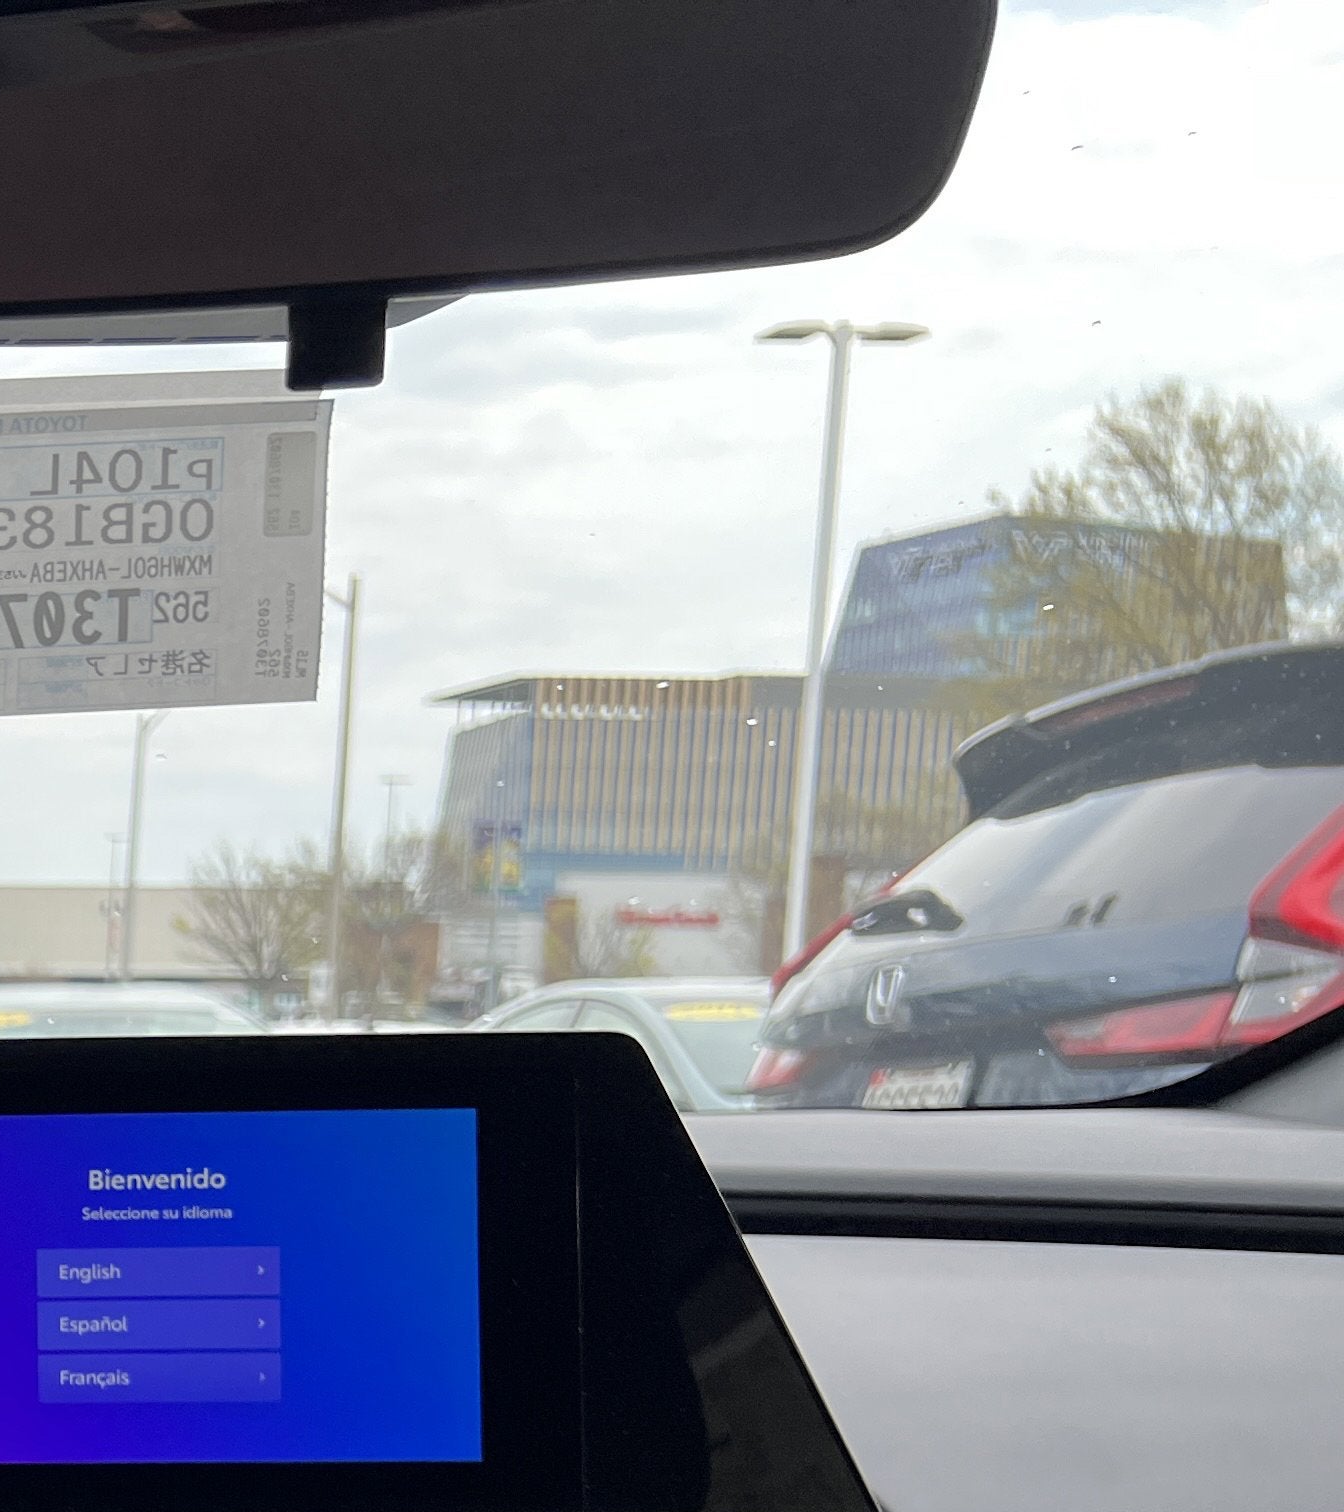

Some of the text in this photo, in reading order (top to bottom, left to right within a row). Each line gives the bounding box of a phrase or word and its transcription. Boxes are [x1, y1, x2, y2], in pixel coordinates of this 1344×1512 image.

[88, 1167, 226, 1191] Bienvenido
[81, 1206, 160, 1221] Seleccione
[162, 1208, 179, 1220] su
[59, 1264, 121, 1284] English
[59, 1315, 128, 1335] Español
[59, 1369, 130, 1389] Français
